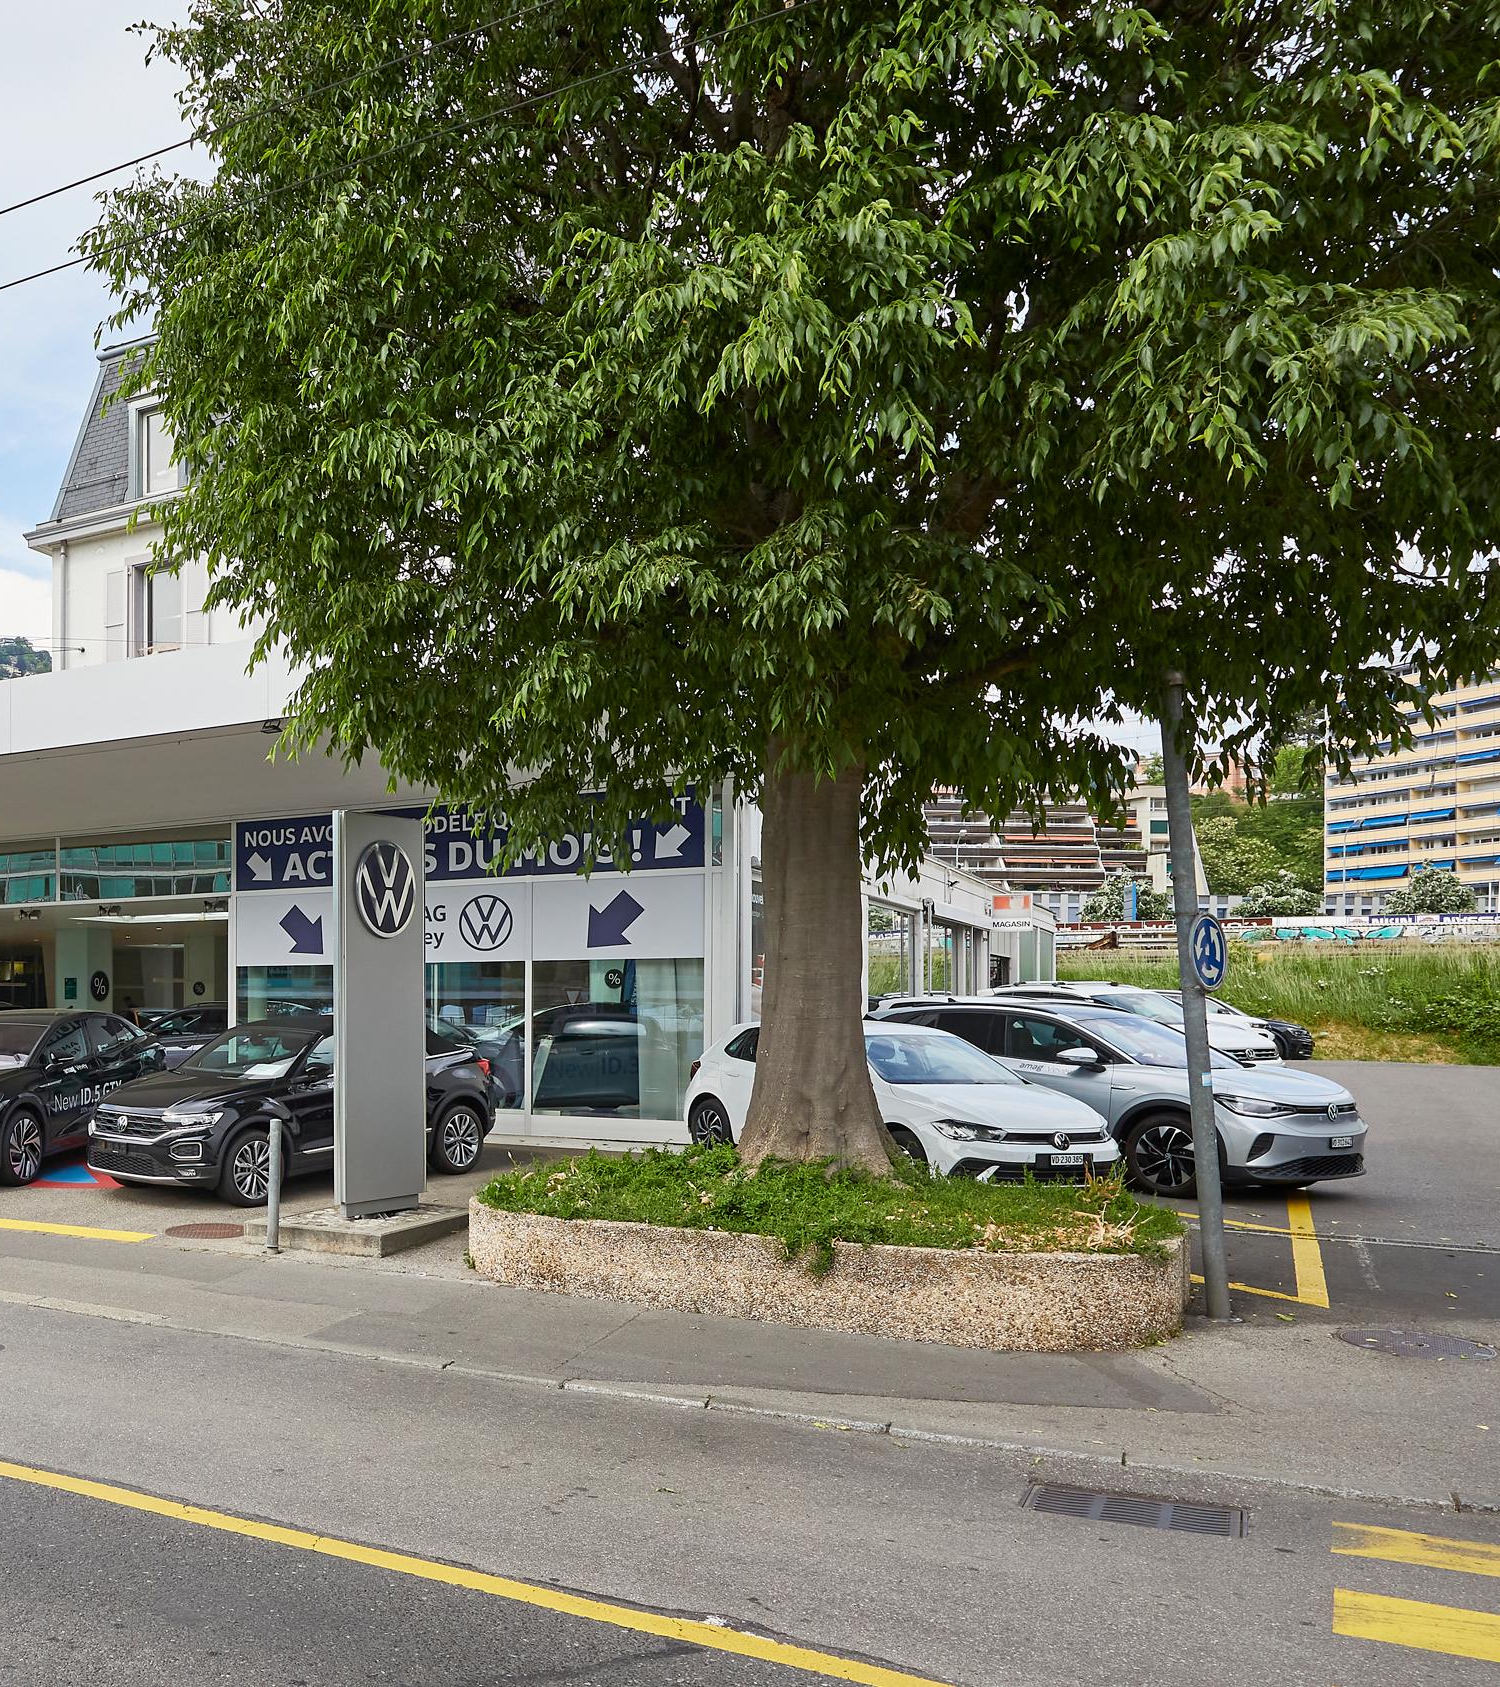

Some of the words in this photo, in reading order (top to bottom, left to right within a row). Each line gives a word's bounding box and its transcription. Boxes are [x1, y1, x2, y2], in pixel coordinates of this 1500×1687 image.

[245, 827, 296, 847] NOUS
[448, 838, 500, 872] DU
[992, 920, 1031, 928] MAGASIN
[1019, 1062, 1044, 1072] amag
[54, 1094, 78, 1112] New
[80, 1085, 100, 1106] ID.5
[1051, 1155, 1059, 1164] VD
[1061, 1155, 1071, 1164] 230
